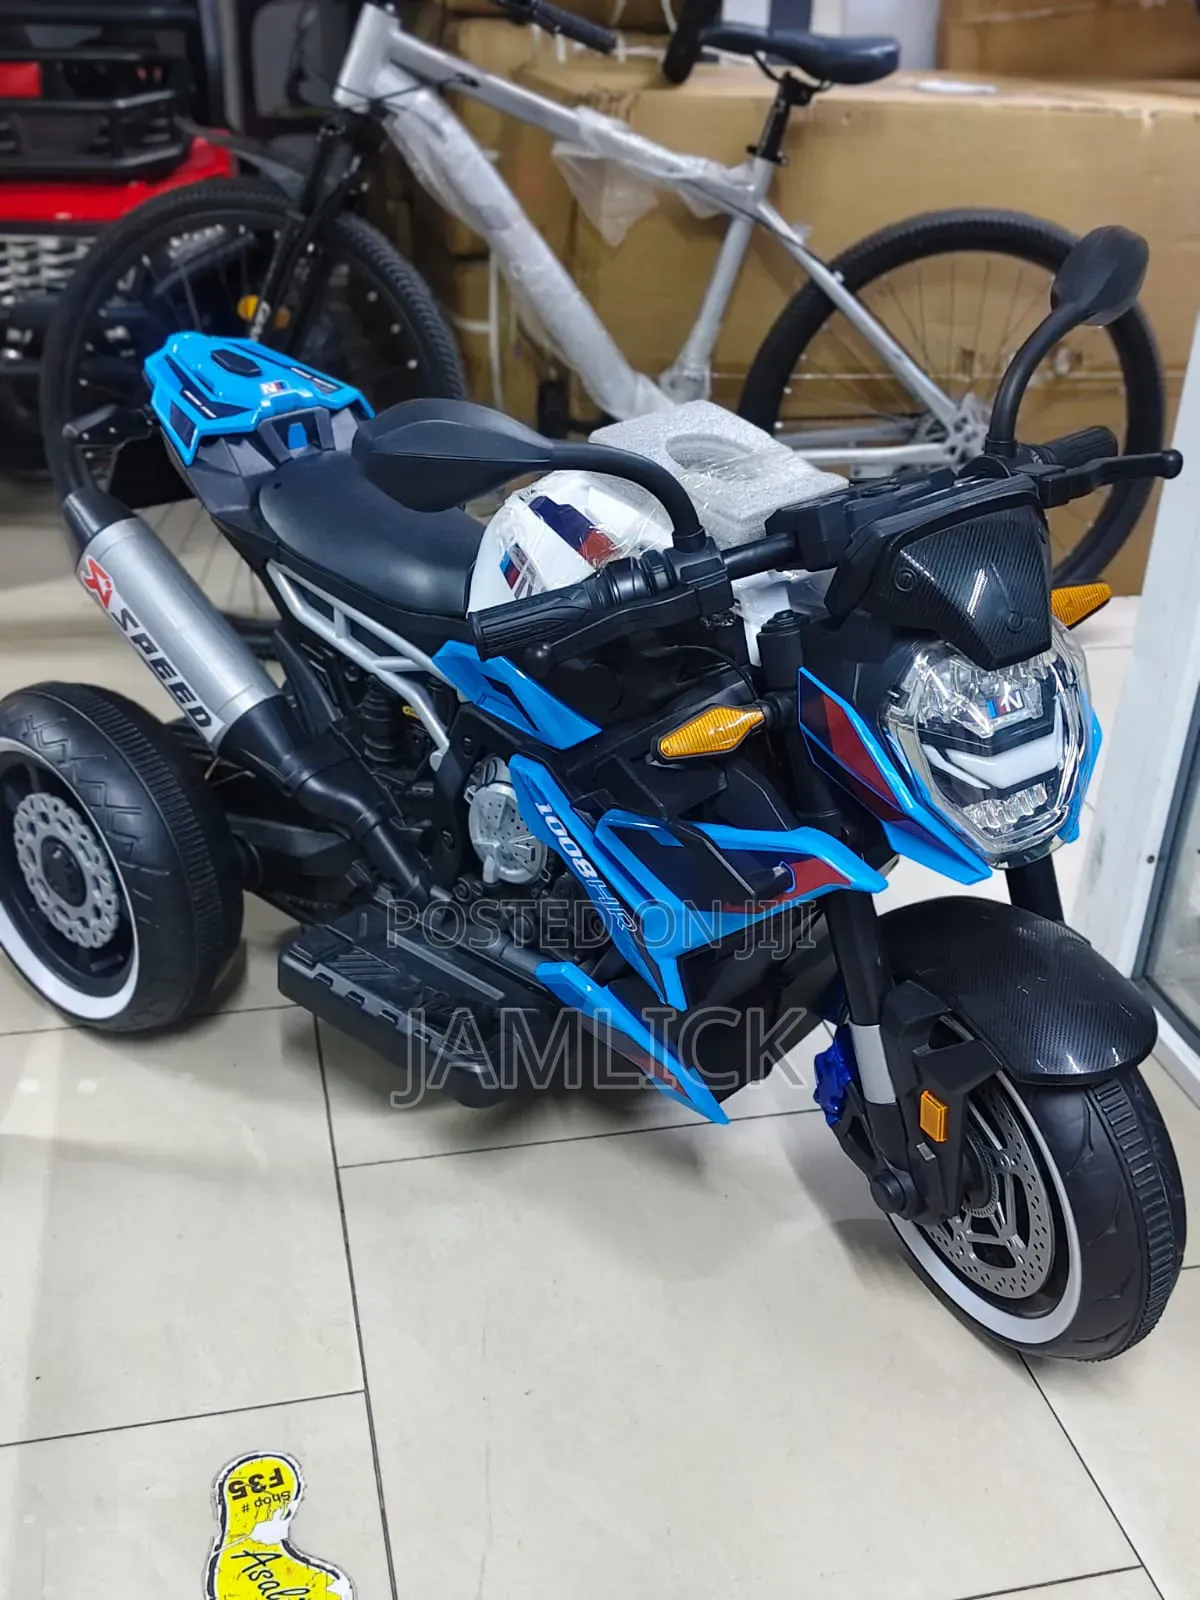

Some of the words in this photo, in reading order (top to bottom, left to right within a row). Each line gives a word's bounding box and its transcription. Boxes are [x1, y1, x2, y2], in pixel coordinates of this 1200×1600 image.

[111, 607, 213, 728] SPEED
[228, 1466, 285, 1501] F35
[253, 1490, 292, 1508] Shop
[230, 1550, 310, 1600] Asal
